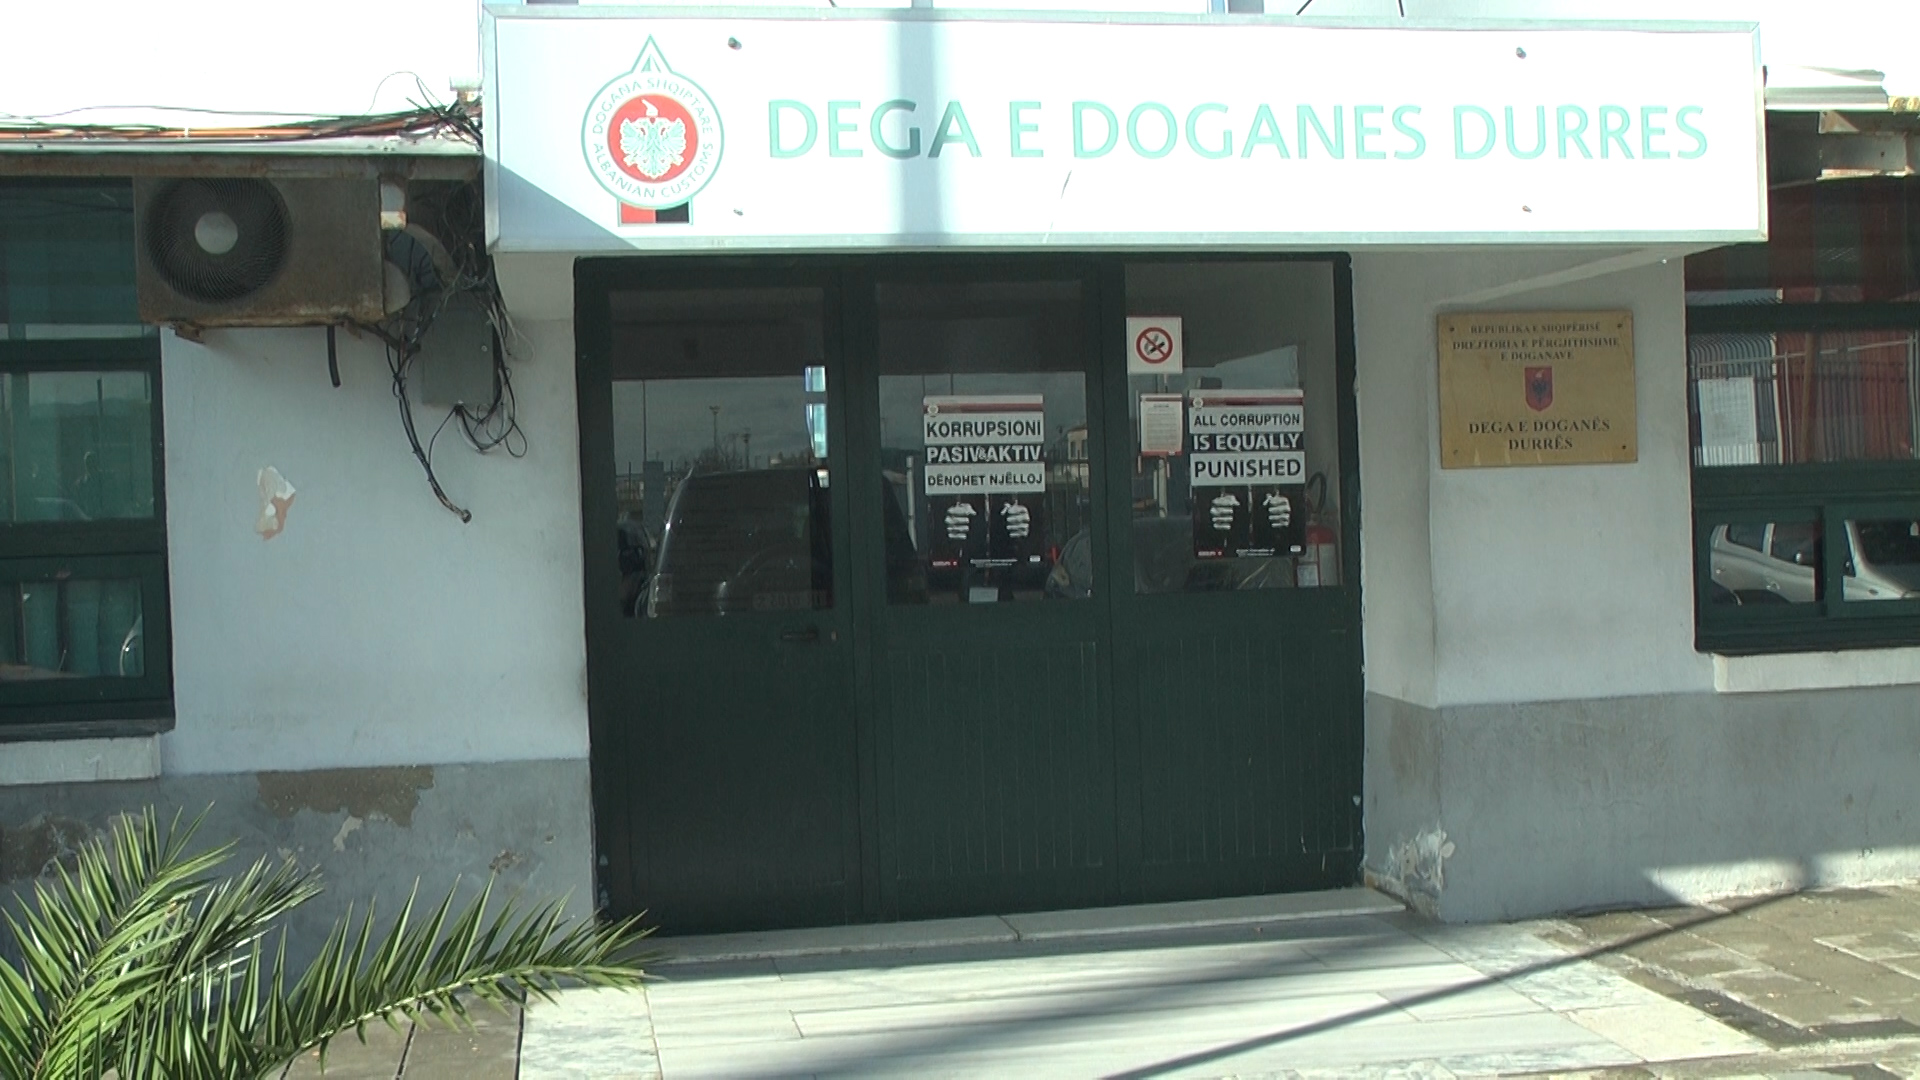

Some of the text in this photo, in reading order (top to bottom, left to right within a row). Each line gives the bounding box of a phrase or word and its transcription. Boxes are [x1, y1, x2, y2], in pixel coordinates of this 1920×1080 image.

[592, 77, 714, 134] DOGANA SHQIPTARE
[768, 99, 1708, 160] DEGA E DOGANES DURRES
[593, 142, 714, 199] ALBANIAN CUSTOMS
[1470, 324, 1530, 334] REPUBLIKA
[1532, 323, 1538, 333] E
[1452, 339, 1519, 350] DREJTORIA
[1521, 339, 1528, 348] E
[1511, 351, 1574, 361] DOGANAVE
[1194, 413, 1300, 426] ALL CORRUPTION
[1469, 416, 1610, 434] DEGA E DOGANËS
[926, 420, 1041, 438] KORRUPSIONI
[1194, 433, 1299, 452] IS EQUALLY
[1509, 436, 1573, 450] DURRËS
[1194, 459, 1301, 478] PUNISHED
[928, 471, 1043, 487] DËNOHET NJËLLOJ
